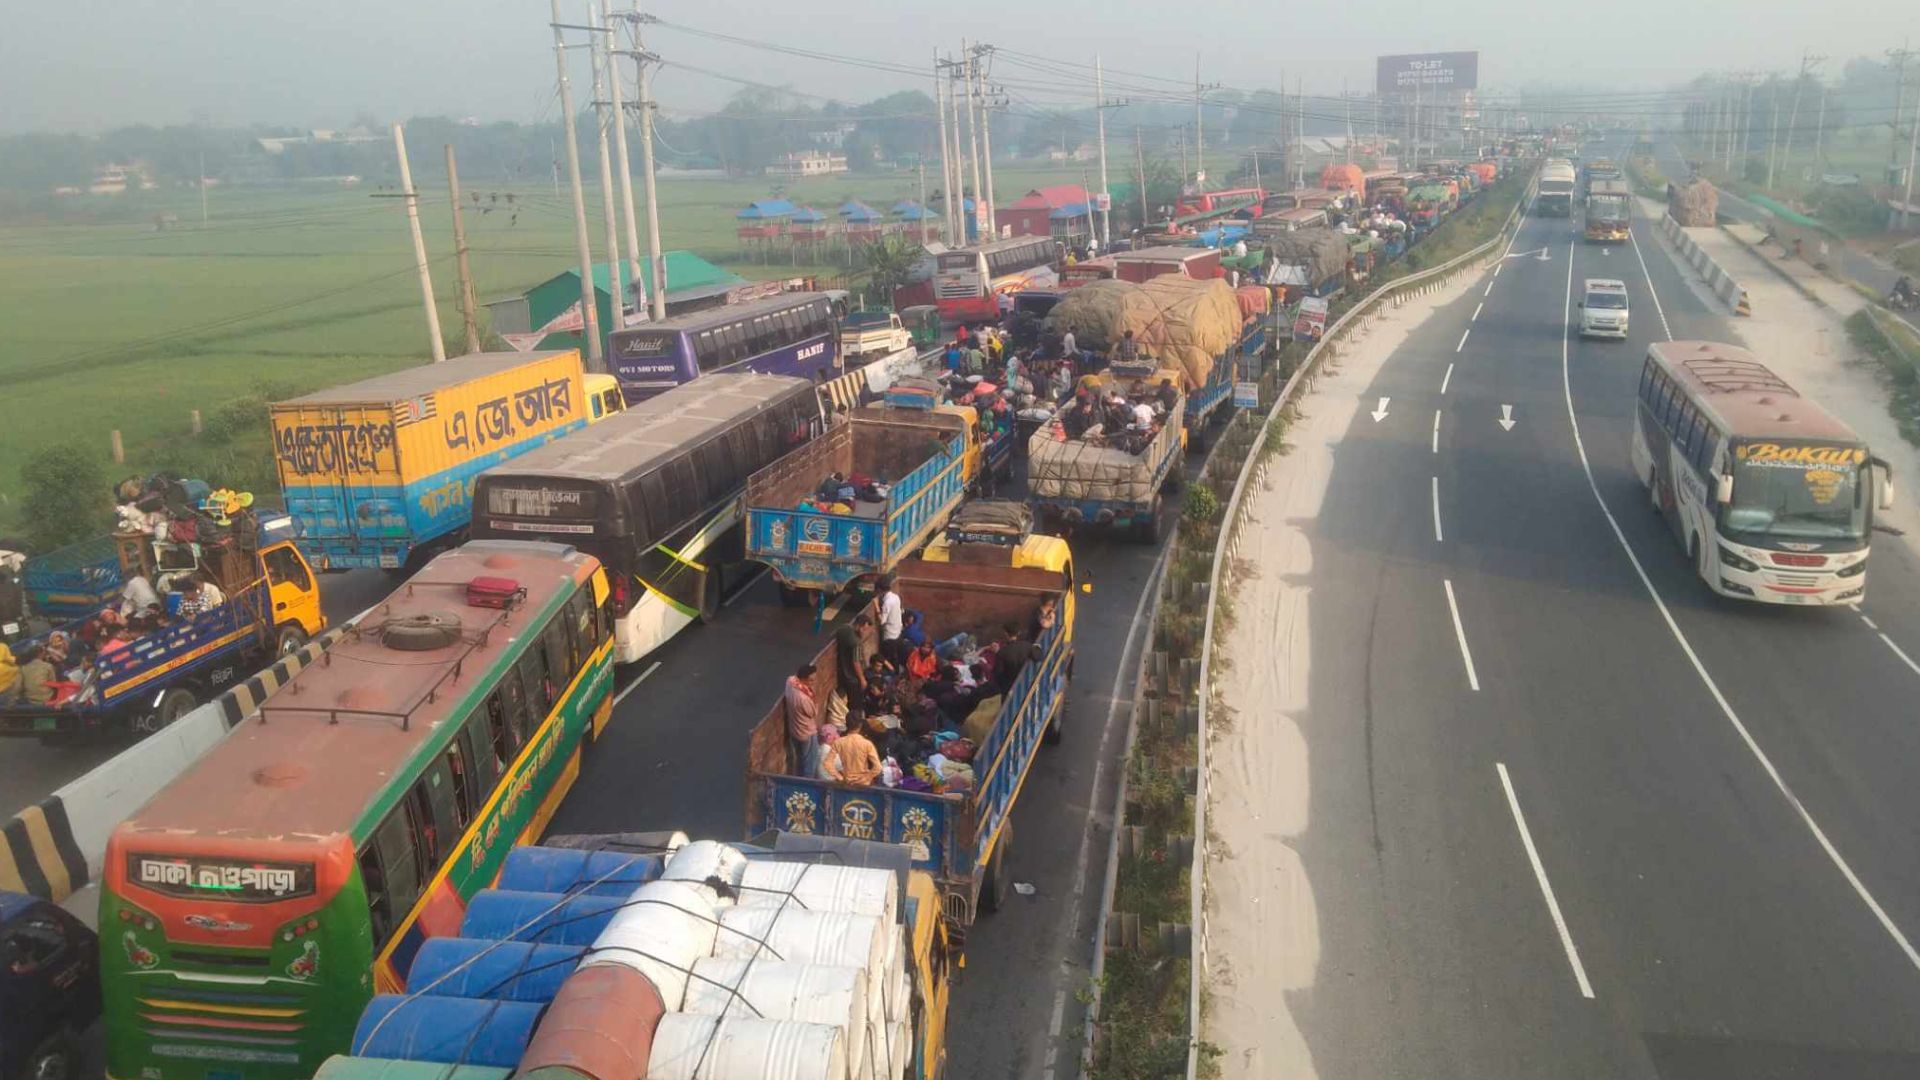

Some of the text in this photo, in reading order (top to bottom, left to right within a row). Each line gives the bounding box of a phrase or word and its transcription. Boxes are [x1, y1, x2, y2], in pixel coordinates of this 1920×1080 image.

[797, 342, 825, 360] HANIF
[637, 365, 675, 374] MOTORS
[842, 823, 876, 839] TATA
[142, 860, 192, 885] ঢাকা
